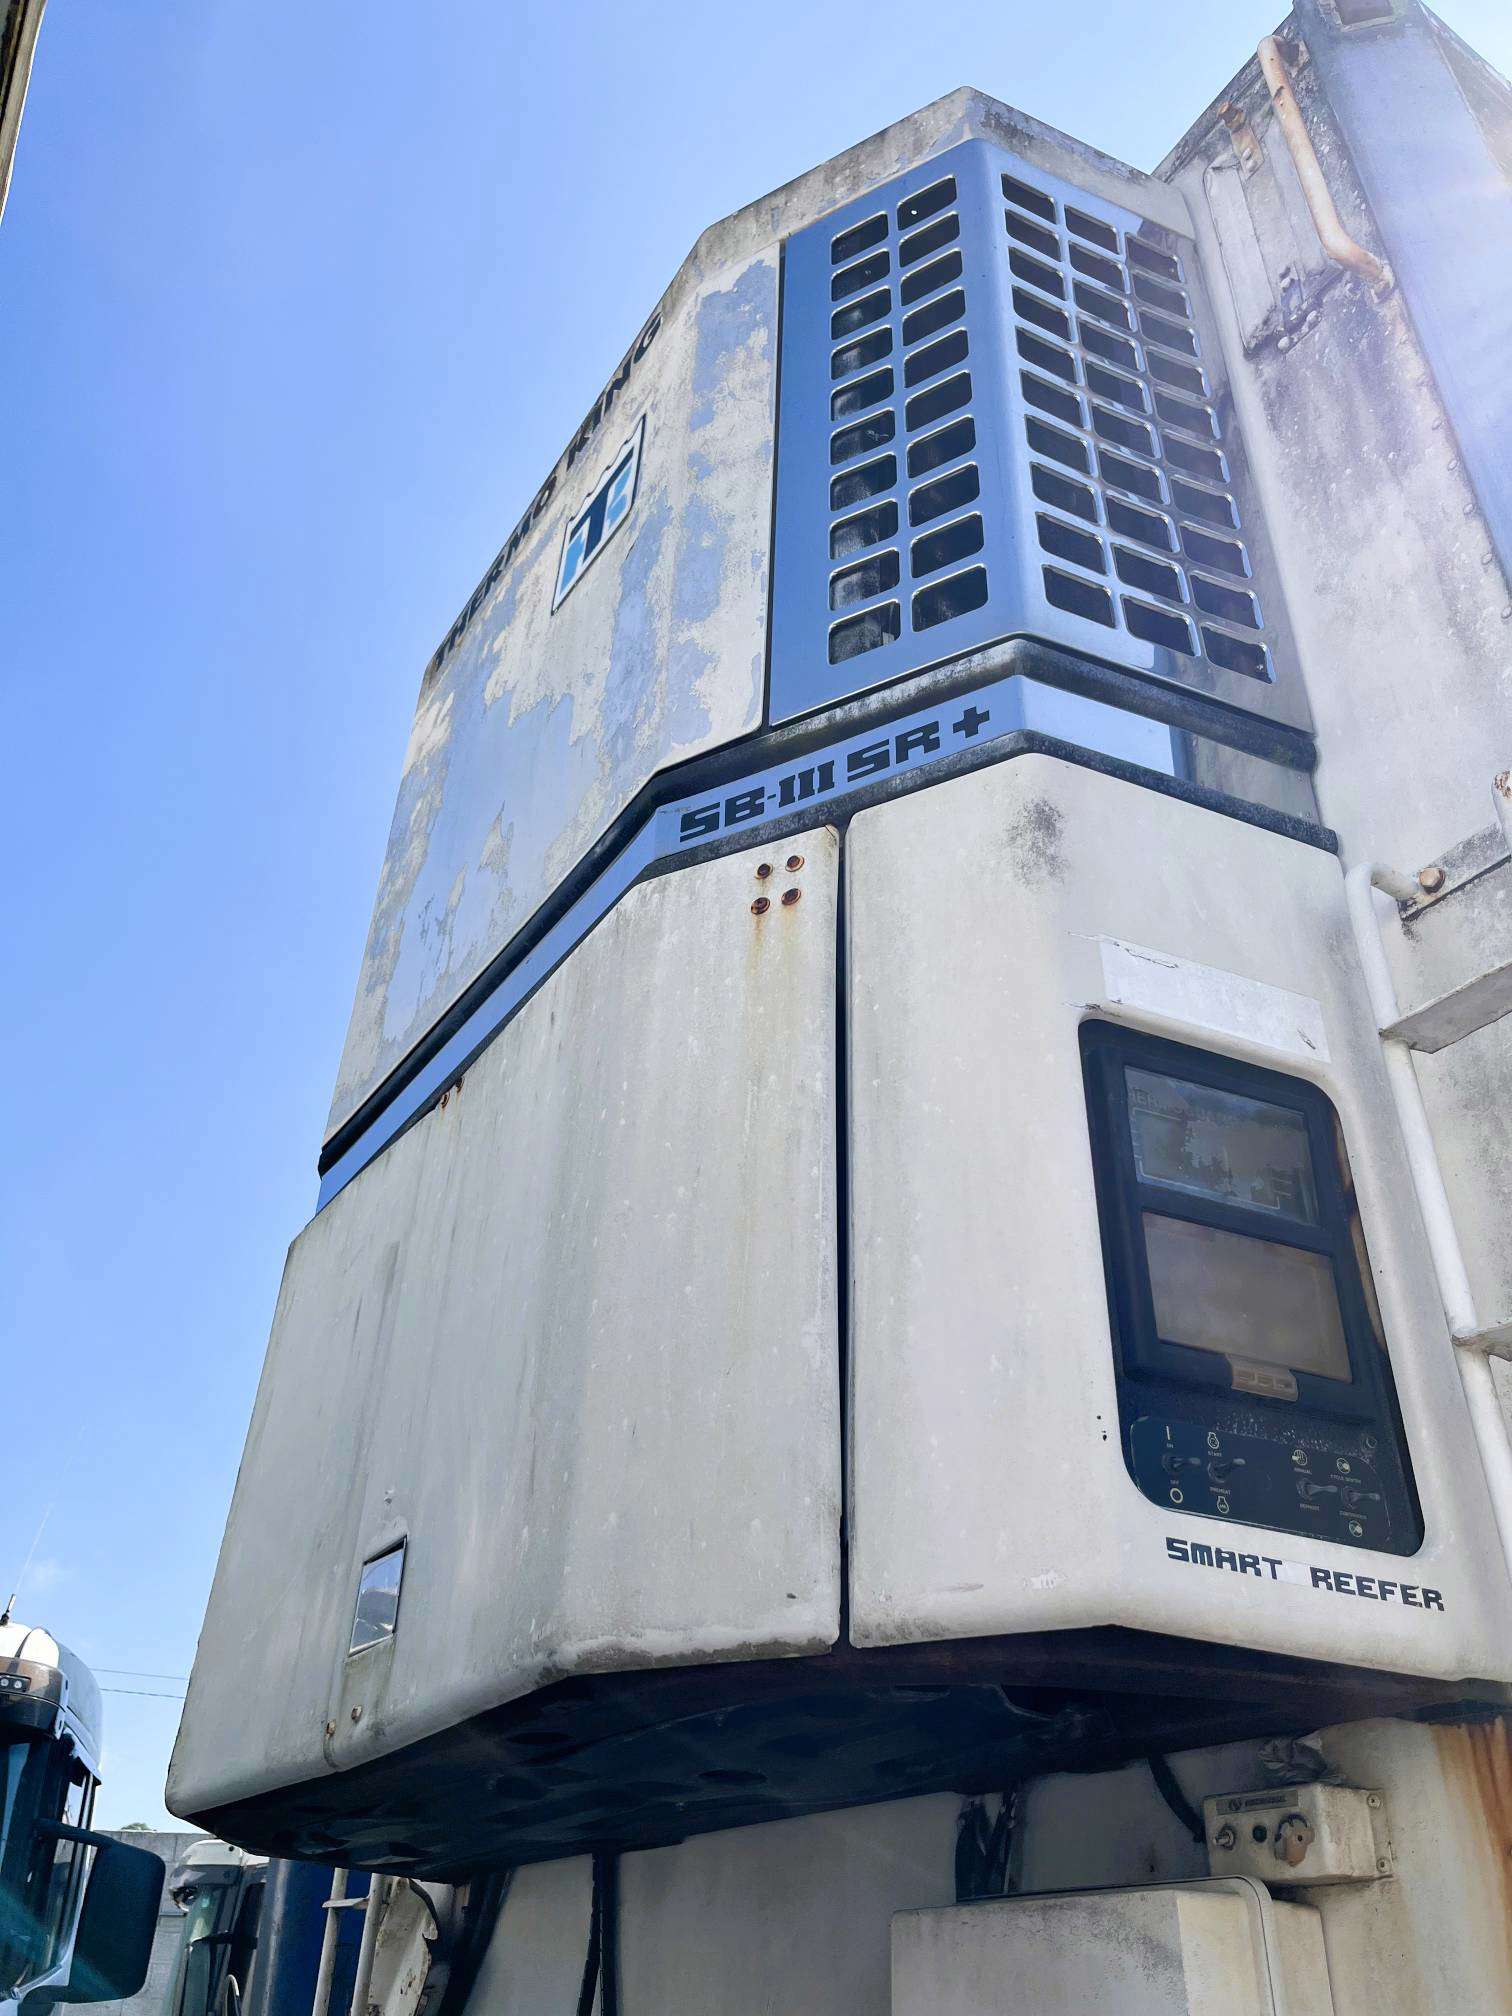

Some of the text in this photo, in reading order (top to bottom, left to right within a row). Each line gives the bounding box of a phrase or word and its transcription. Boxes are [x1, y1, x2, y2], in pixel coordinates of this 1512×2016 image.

[433, 311, 662, 672] THERMO KING
[679, 758, 835, 843] SB-III
[1165, 1536, 1446, 1612] SMART REEFER
